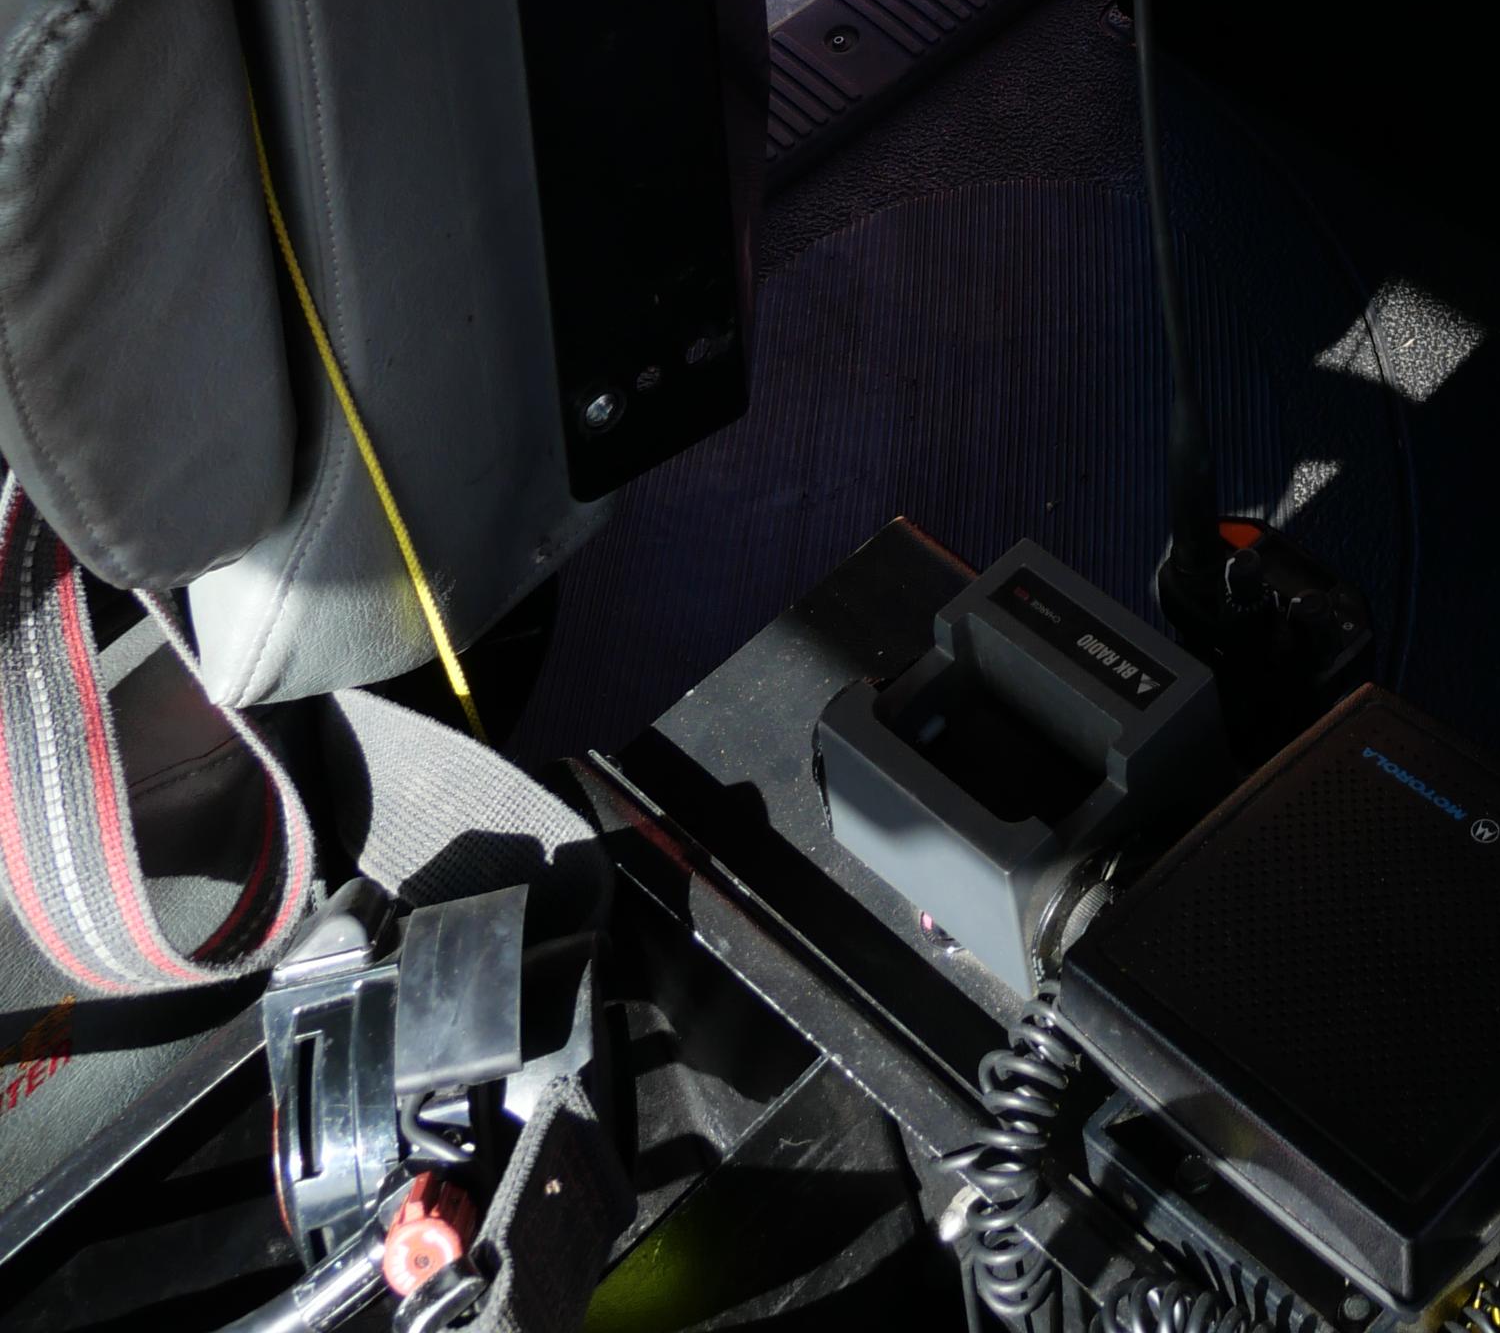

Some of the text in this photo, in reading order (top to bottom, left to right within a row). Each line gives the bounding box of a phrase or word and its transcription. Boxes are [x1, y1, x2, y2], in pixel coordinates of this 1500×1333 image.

[1076, 633, 1140, 680] BK RADIO
[1362, 746, 1469, 821] MOTOROLA
[0, 1037, 73, 1116] TER
